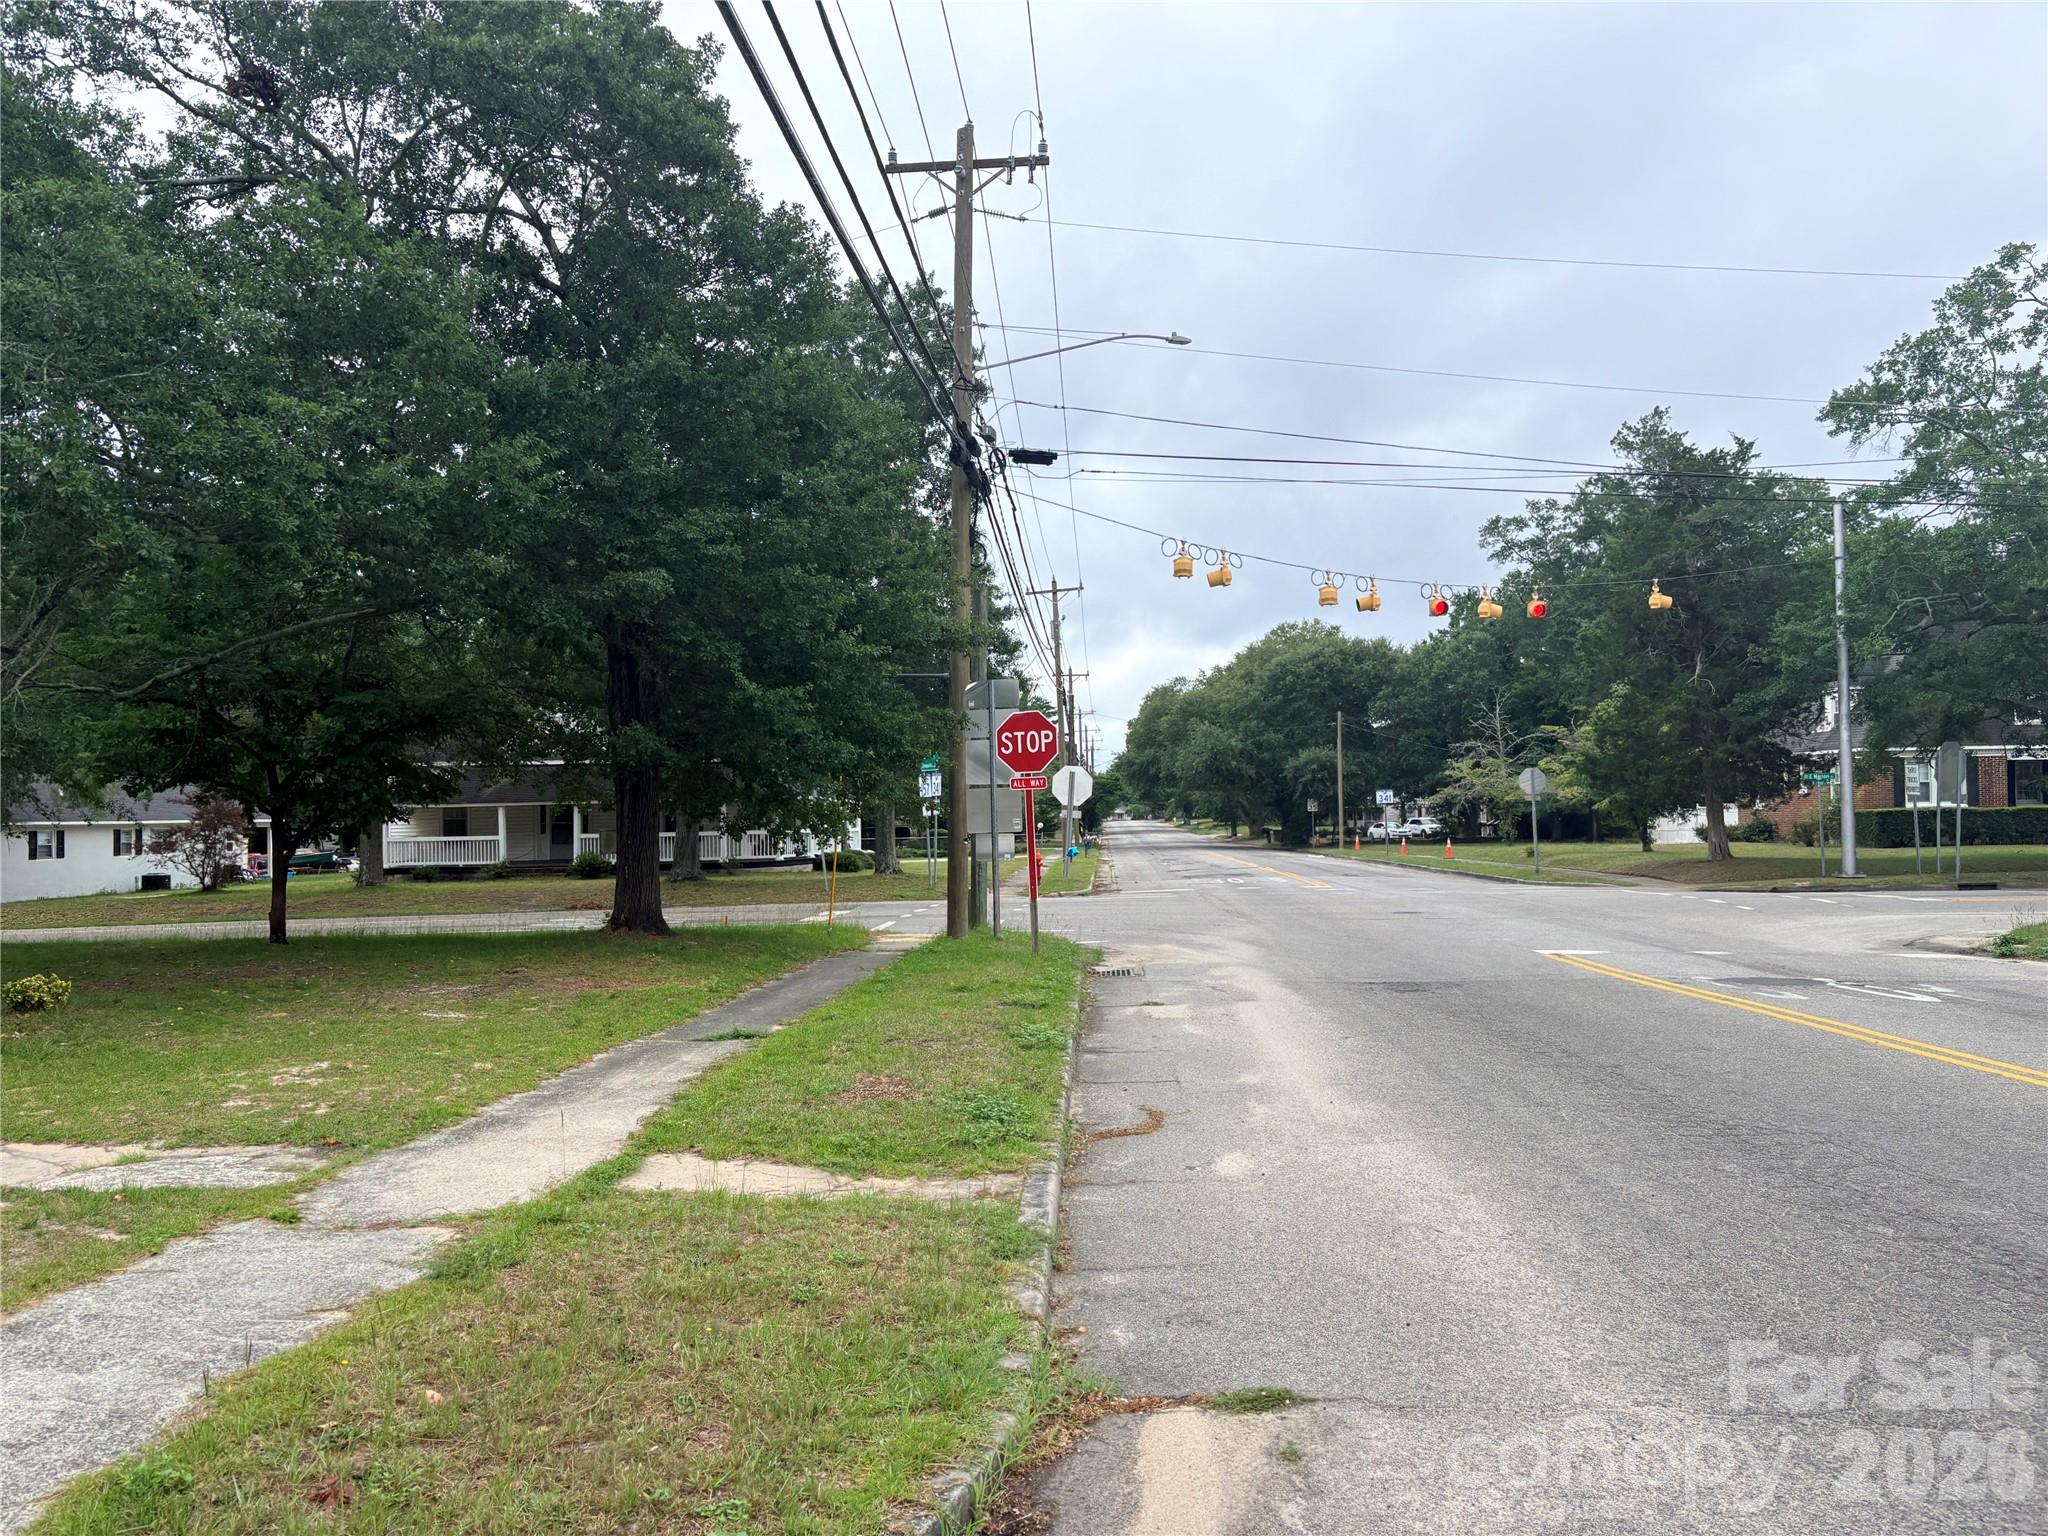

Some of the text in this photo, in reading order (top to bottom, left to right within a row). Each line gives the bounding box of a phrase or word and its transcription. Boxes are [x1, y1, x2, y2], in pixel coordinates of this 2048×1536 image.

[1000, 731, 1053, 754] STOP
[1013, 778, 1045, 788] ALL WAY
[1378, 794, 1391, 802] 341
